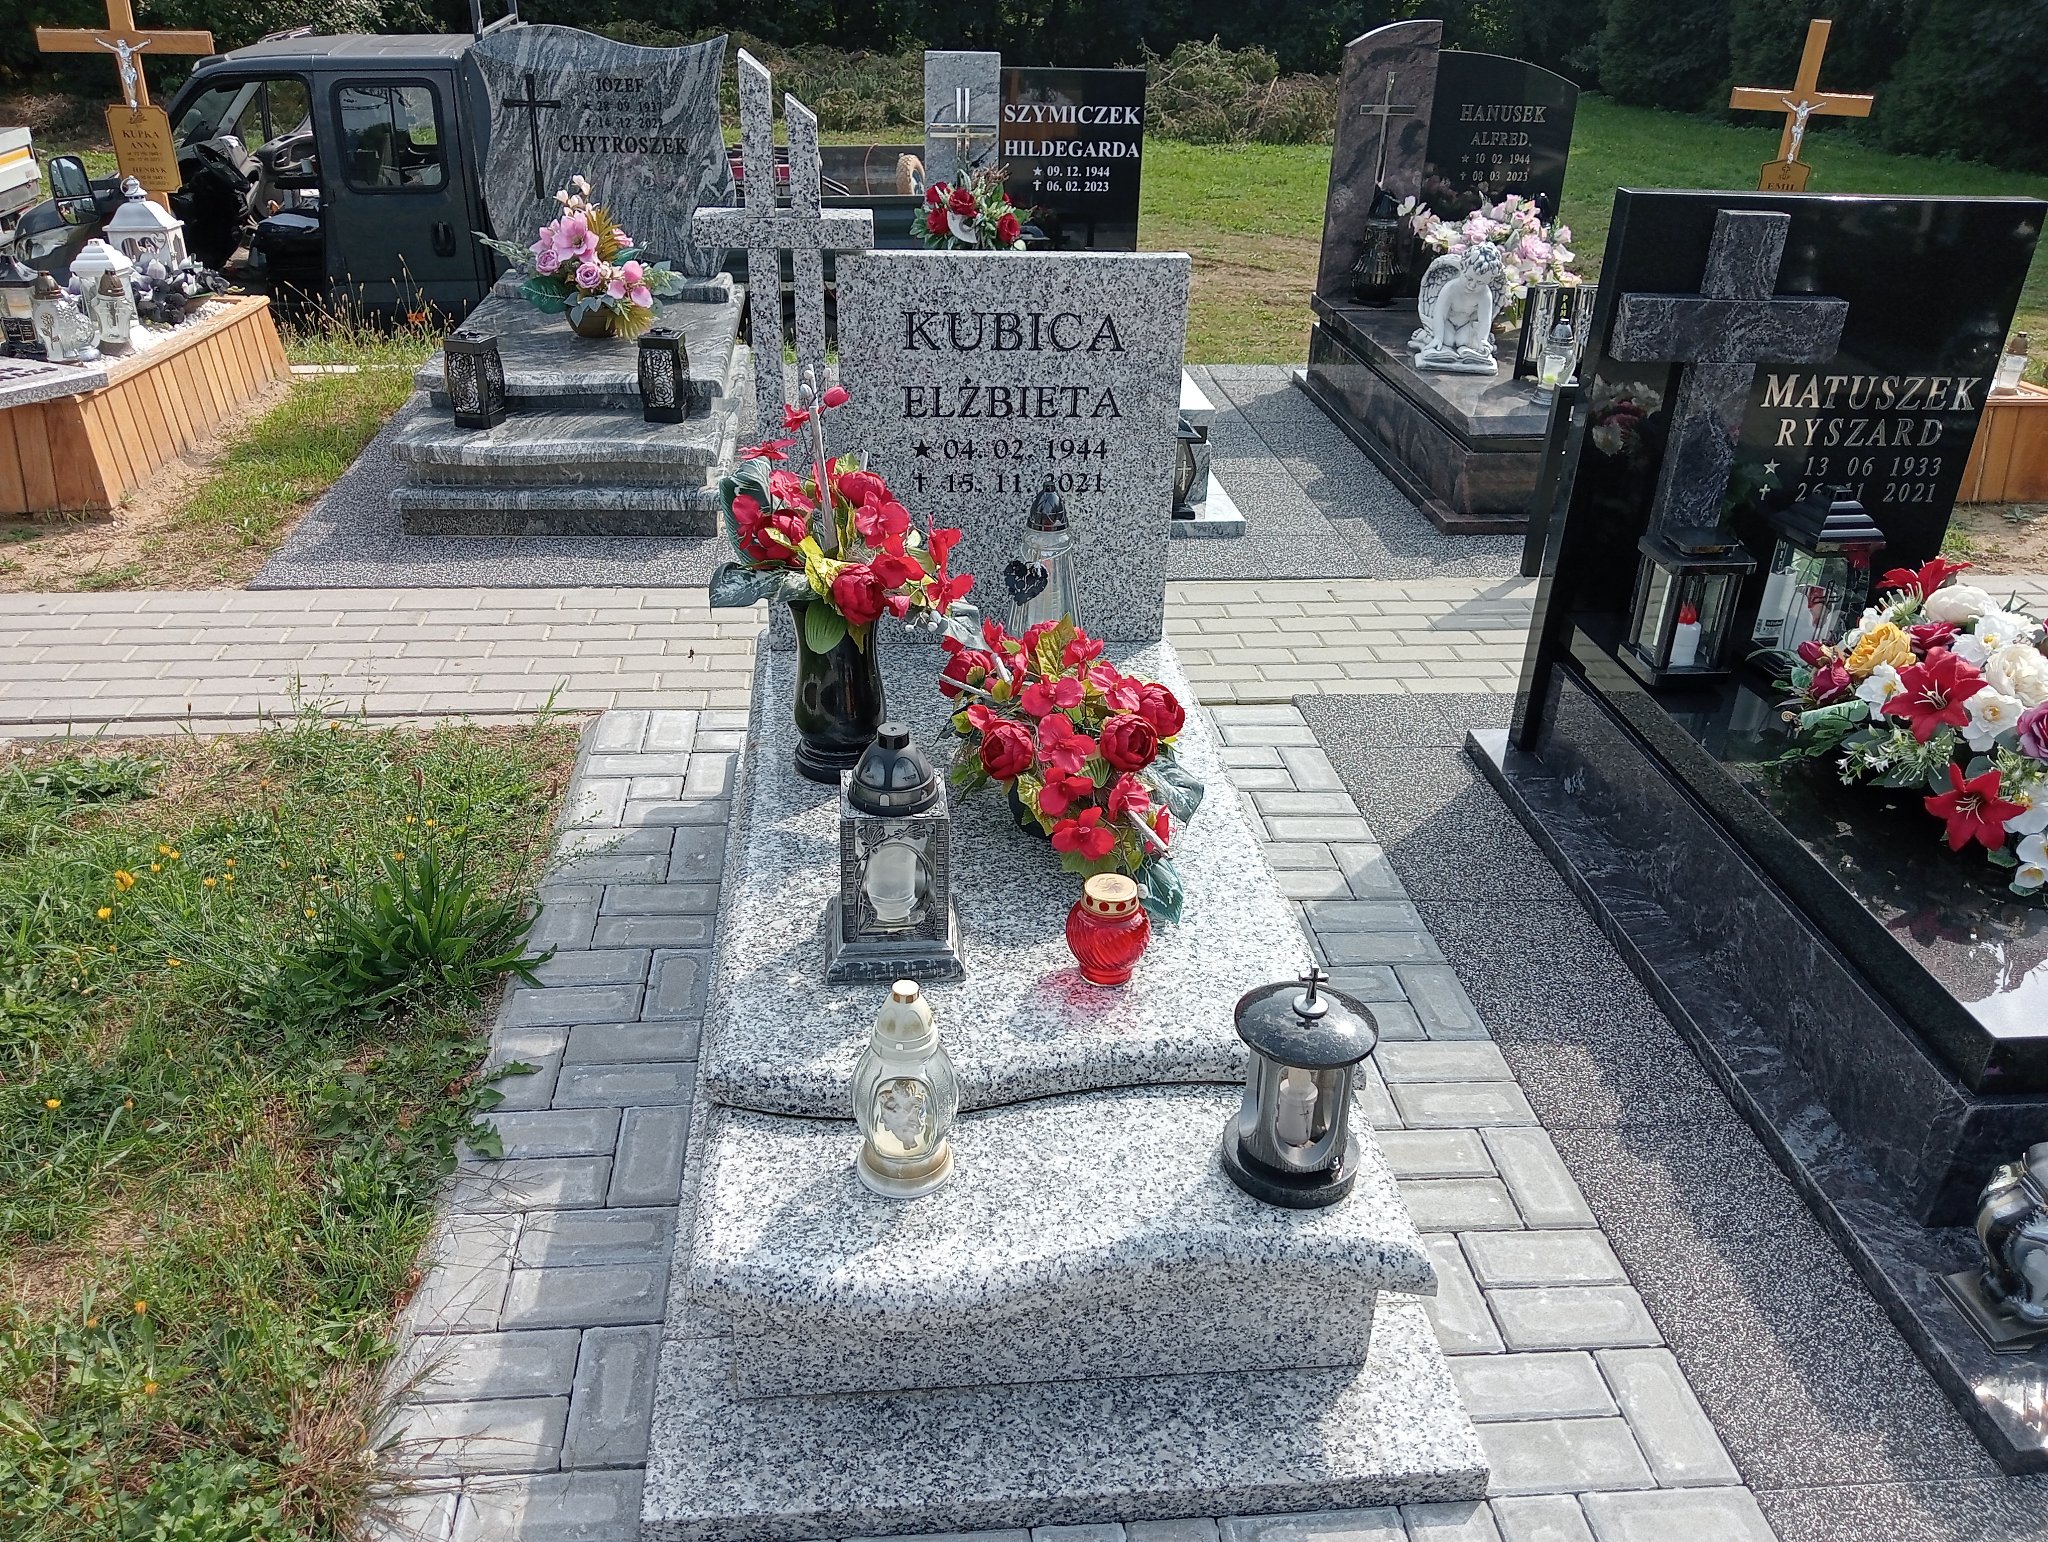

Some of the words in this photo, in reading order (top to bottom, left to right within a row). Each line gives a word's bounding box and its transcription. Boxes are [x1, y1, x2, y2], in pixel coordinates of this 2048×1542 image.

[618, 100, 630, 112] 09
[1004, 104, 1141, 124] SZYMICZEK
[1460, 104, 1547, 123] HANUSEK
[558, 135, 688, 154] CHYTROSZEK
[1004, 140, 1140, 158] HILDEGARDA
[1475, 153, 1486, 164] 10
[1491, 153, 1503, 164] 02
[1509, 153, 1530, 164] 1944
[1047, 165, 1063, 177] 09.
[1066, 165, 1081, 177] 12.
[1085, 166, 1110, 177] 1944
[1489, 171, 1500, 182] 03
[1506, 171, 1528, 182] 2023
[1046, 180, 1062, 192] 06.
[1065, 180, 1081, 192] 02.
[1084, 181, 1109, 192] 2023
[901, 311, 1125, 351] KUBICA
[901, 375, 1123, 419] ELŻBIETA
[1760, 373, 1982, 411] MATUSZEK
[1774, 418, 1944, 447] RYSZARD
[943, 439, 983, 460] 04.
[994, 439, 1033, 460] 02.
[1047, 439, 1108, 460] 1944
[1804, 456, 1830, 476] 13
[1847, 456, 1876, 477] 06
[1890, 456, 1942, 477] 1933
[1846, 482, 1865, 502] 1
[1882, 482, 1937, 503] 2021
